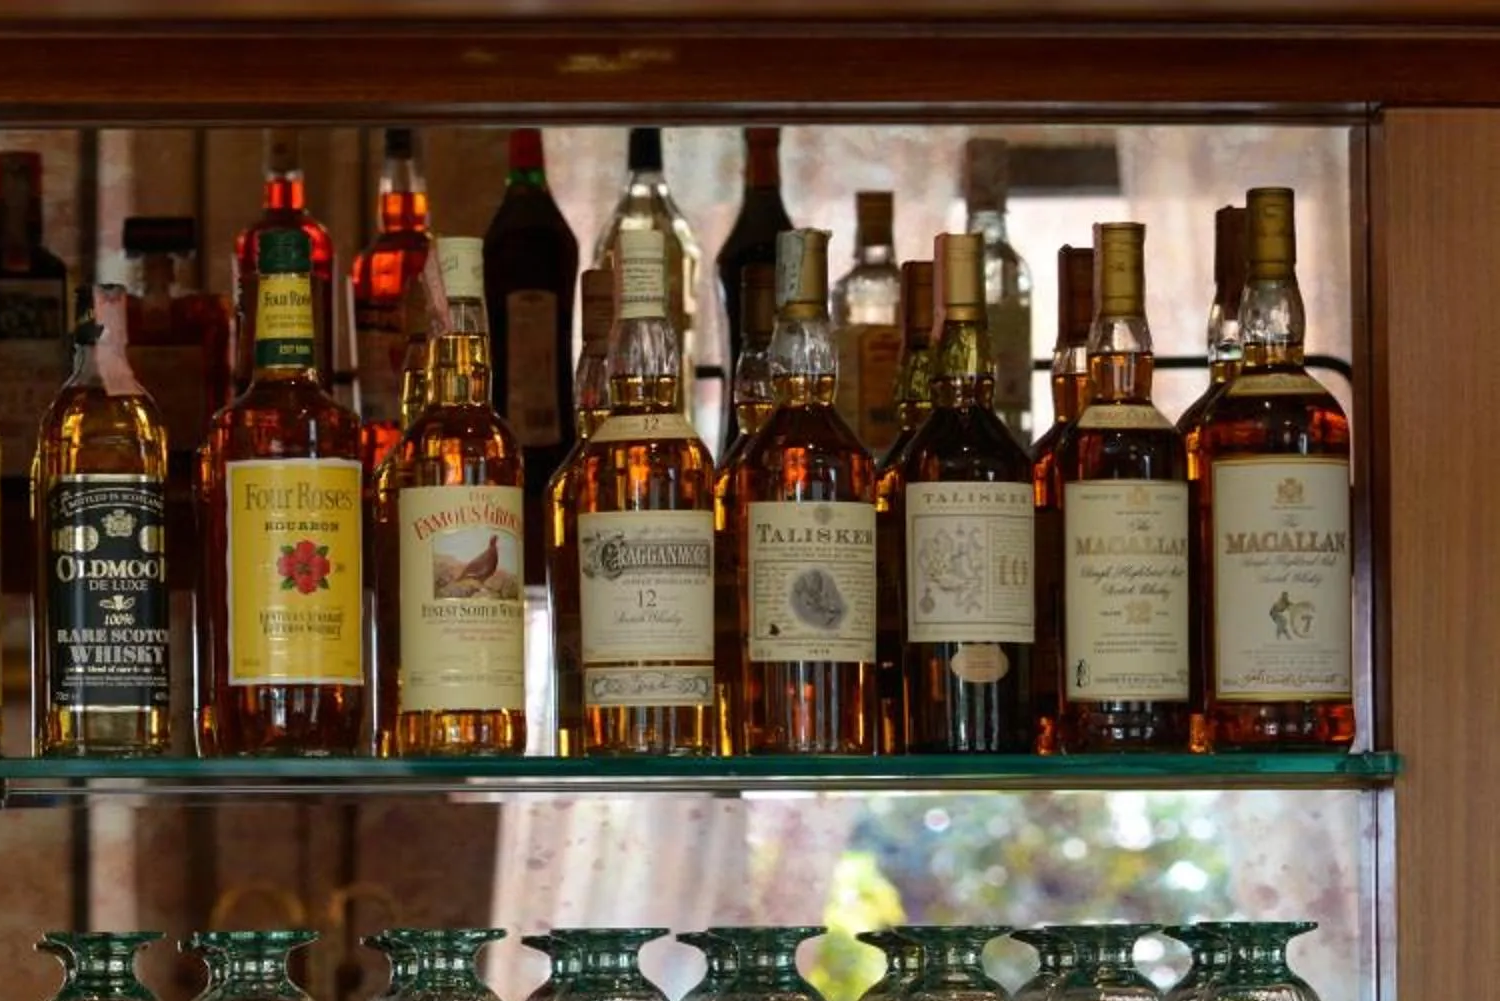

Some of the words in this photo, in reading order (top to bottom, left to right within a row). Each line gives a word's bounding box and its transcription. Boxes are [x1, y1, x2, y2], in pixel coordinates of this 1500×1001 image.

[245, 483, 293, 511] Four
[297, 481, 353, 511] Roses
[264, 521, 340, 531] BOURBON
[413, 506, 481, 540] FAMOUS
[1225, 531, 1346, 555] MACALLAN
[89, 580, 108, 591] DE
[113, 579, 149, 591] LUXE
[638, 588, 657, 608] 12
[104, 613, 135, 626] 100%
[57, 629, 108, 643] RARE
[68, 646, 165, 664] WHISKY
